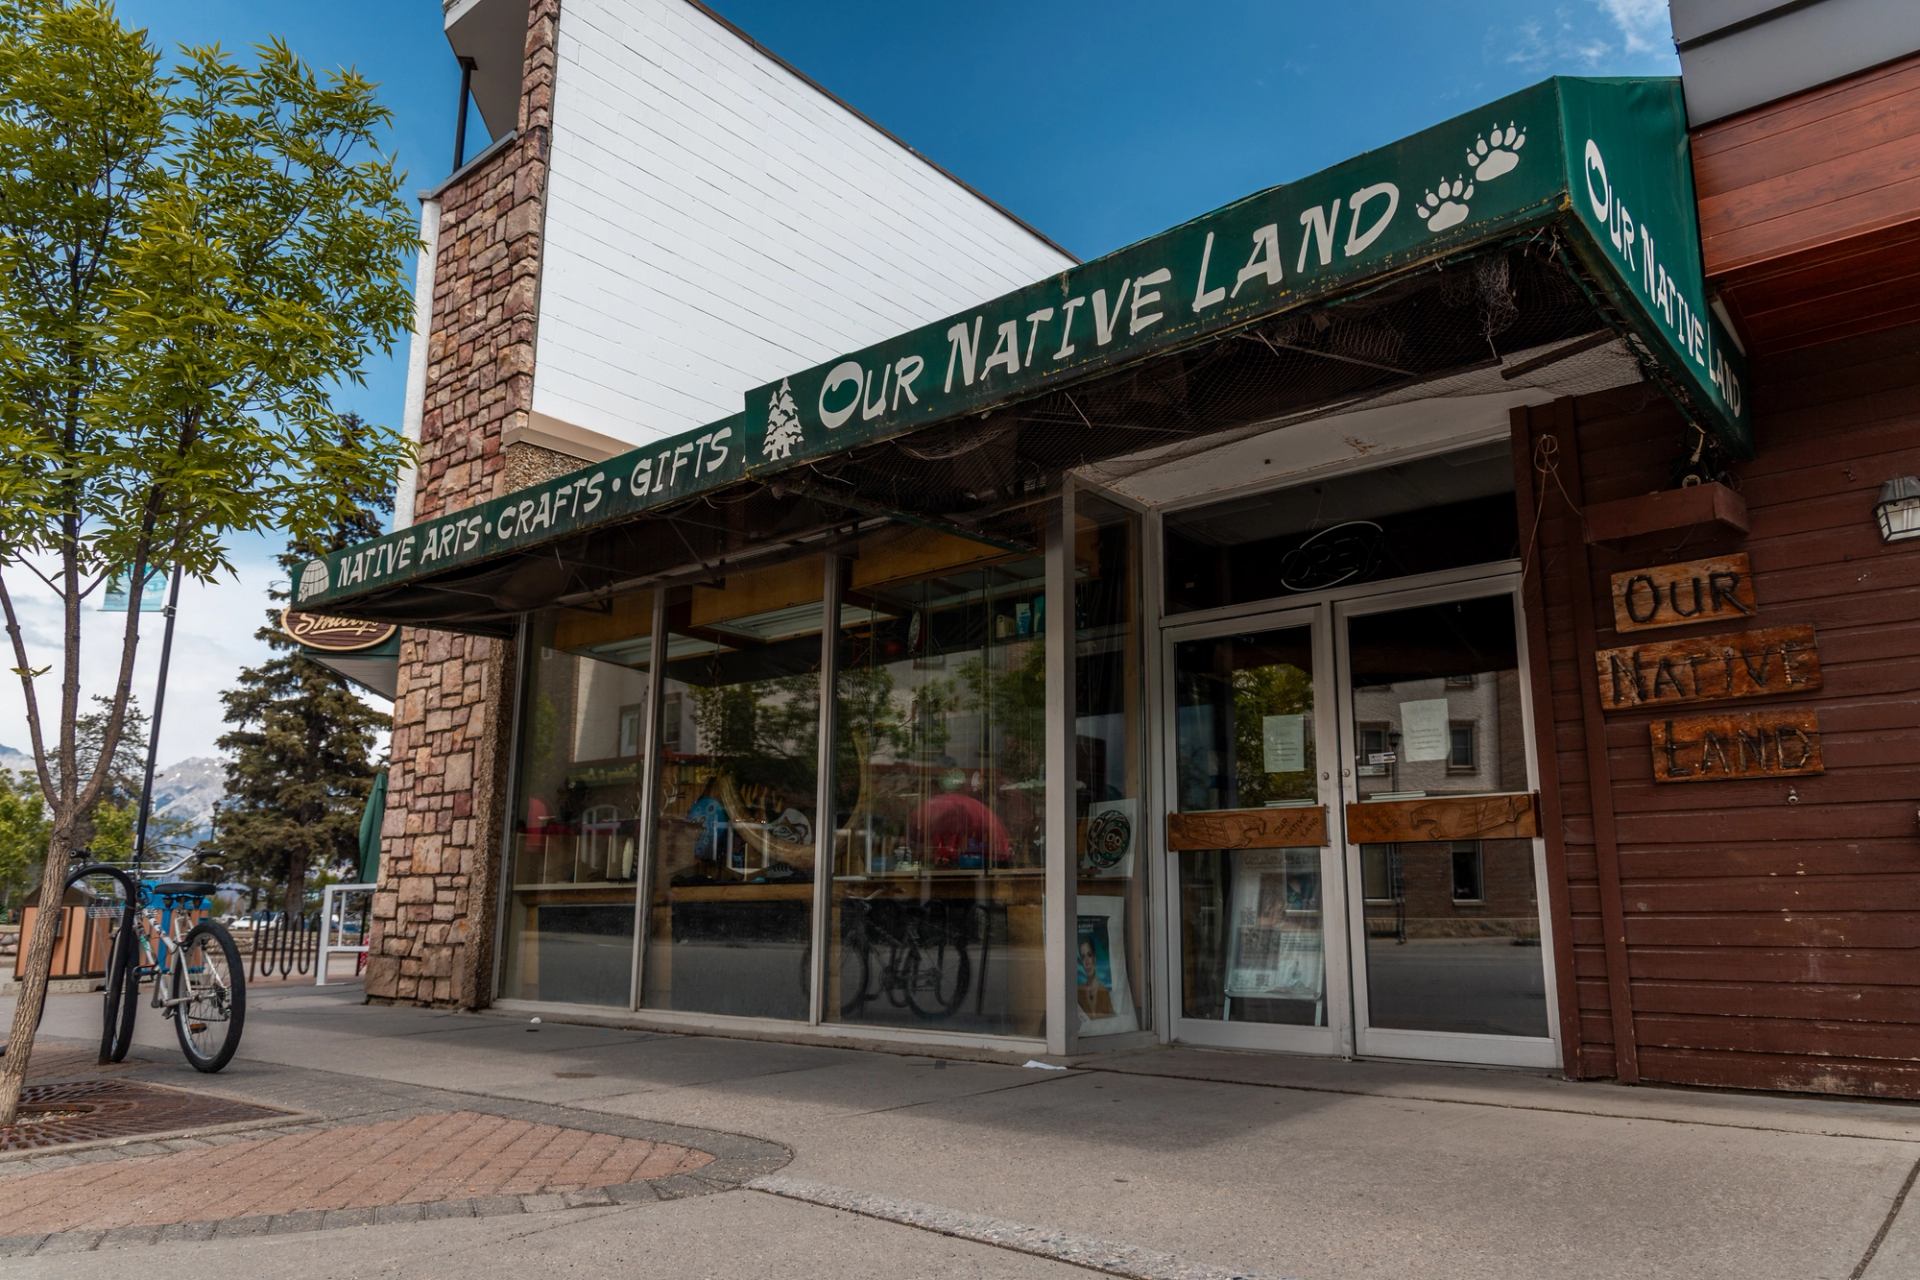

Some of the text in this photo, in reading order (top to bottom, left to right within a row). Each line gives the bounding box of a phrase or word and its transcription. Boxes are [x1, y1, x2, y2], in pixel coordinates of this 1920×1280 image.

[818, 182, 1400, 429] OUR NATIVE LAND
[1585, 139, 1741, 418] OUR NATIVE LAND
[337, 426, 733, 588] NATIVE ARTS CRAFTS GIFTS
[1625, 571, 1751, 623] OUR
[1610, 640, 1809, 704] NATIVE
[1665, 720, 1811, 777] LAND
